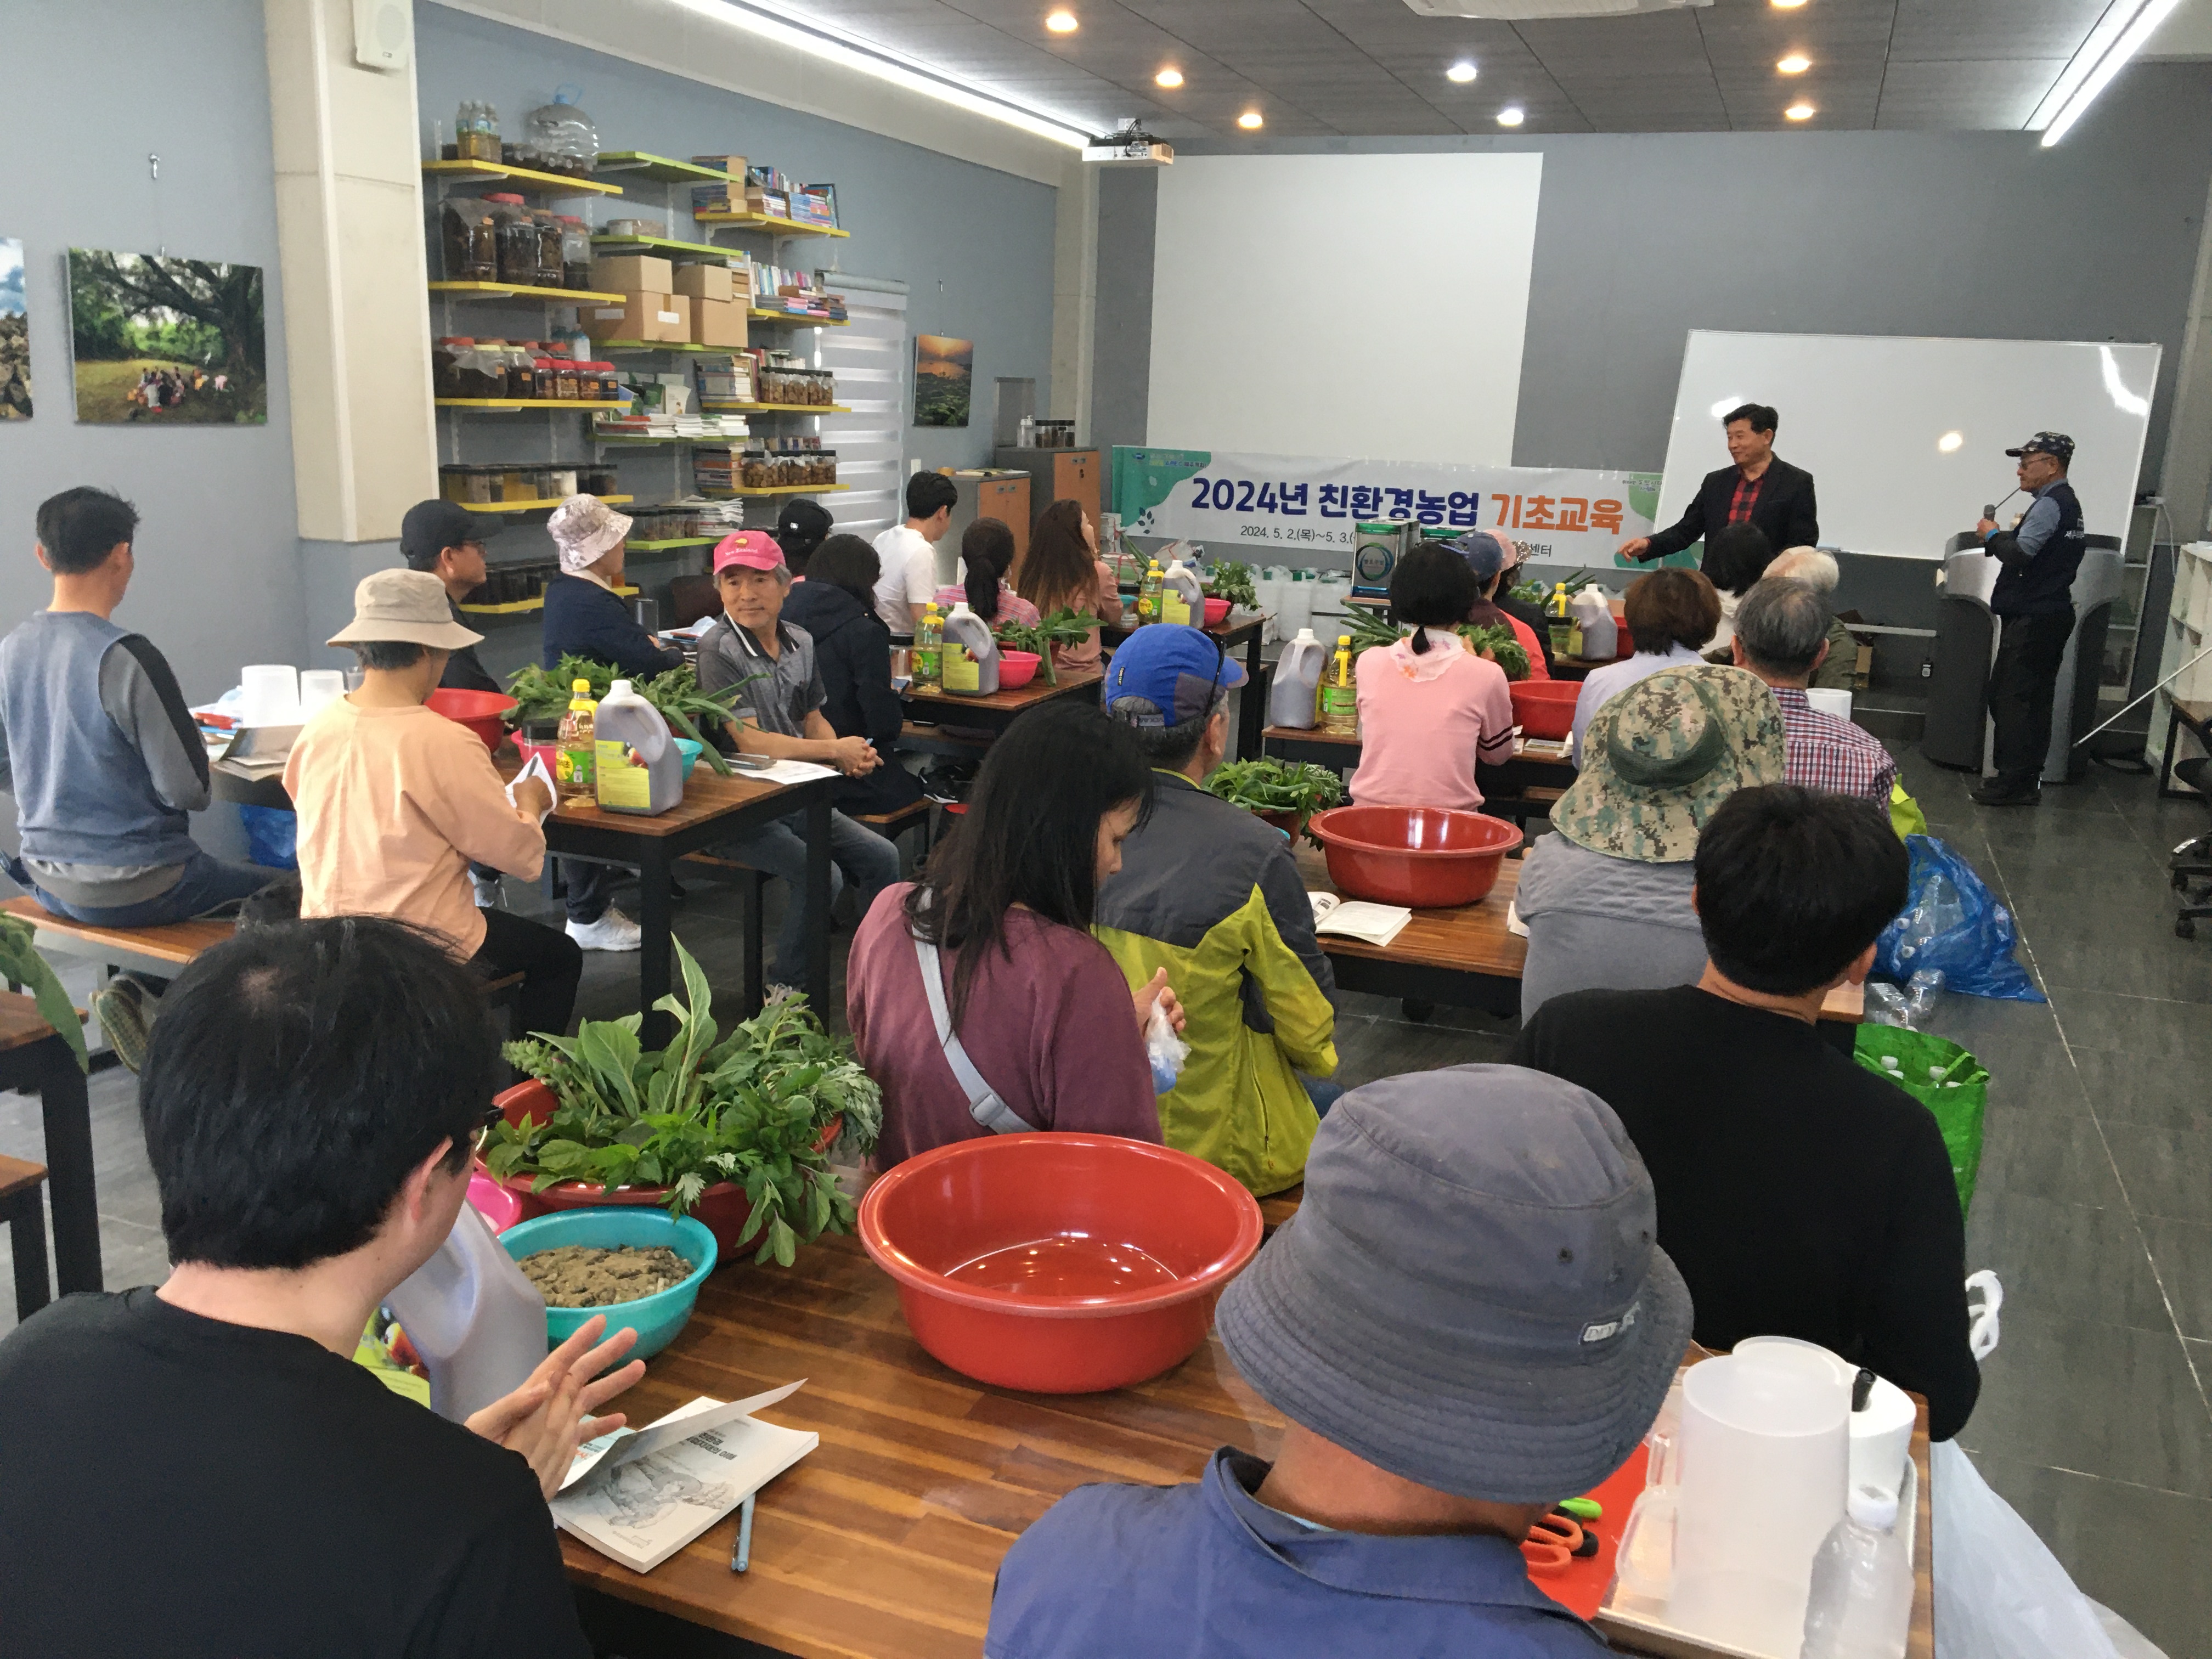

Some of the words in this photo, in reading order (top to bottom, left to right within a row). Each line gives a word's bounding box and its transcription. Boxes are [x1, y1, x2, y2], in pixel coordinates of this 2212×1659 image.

[1192, 477, 1309, 516] 2024년
[1318, 482, 1480, 527] 친환경농업
[1492, 493, 1623, 535] 기초교육
[1240, 525, 1269, 538] 2024.
[1273, 528, 1283, 539] 5.
